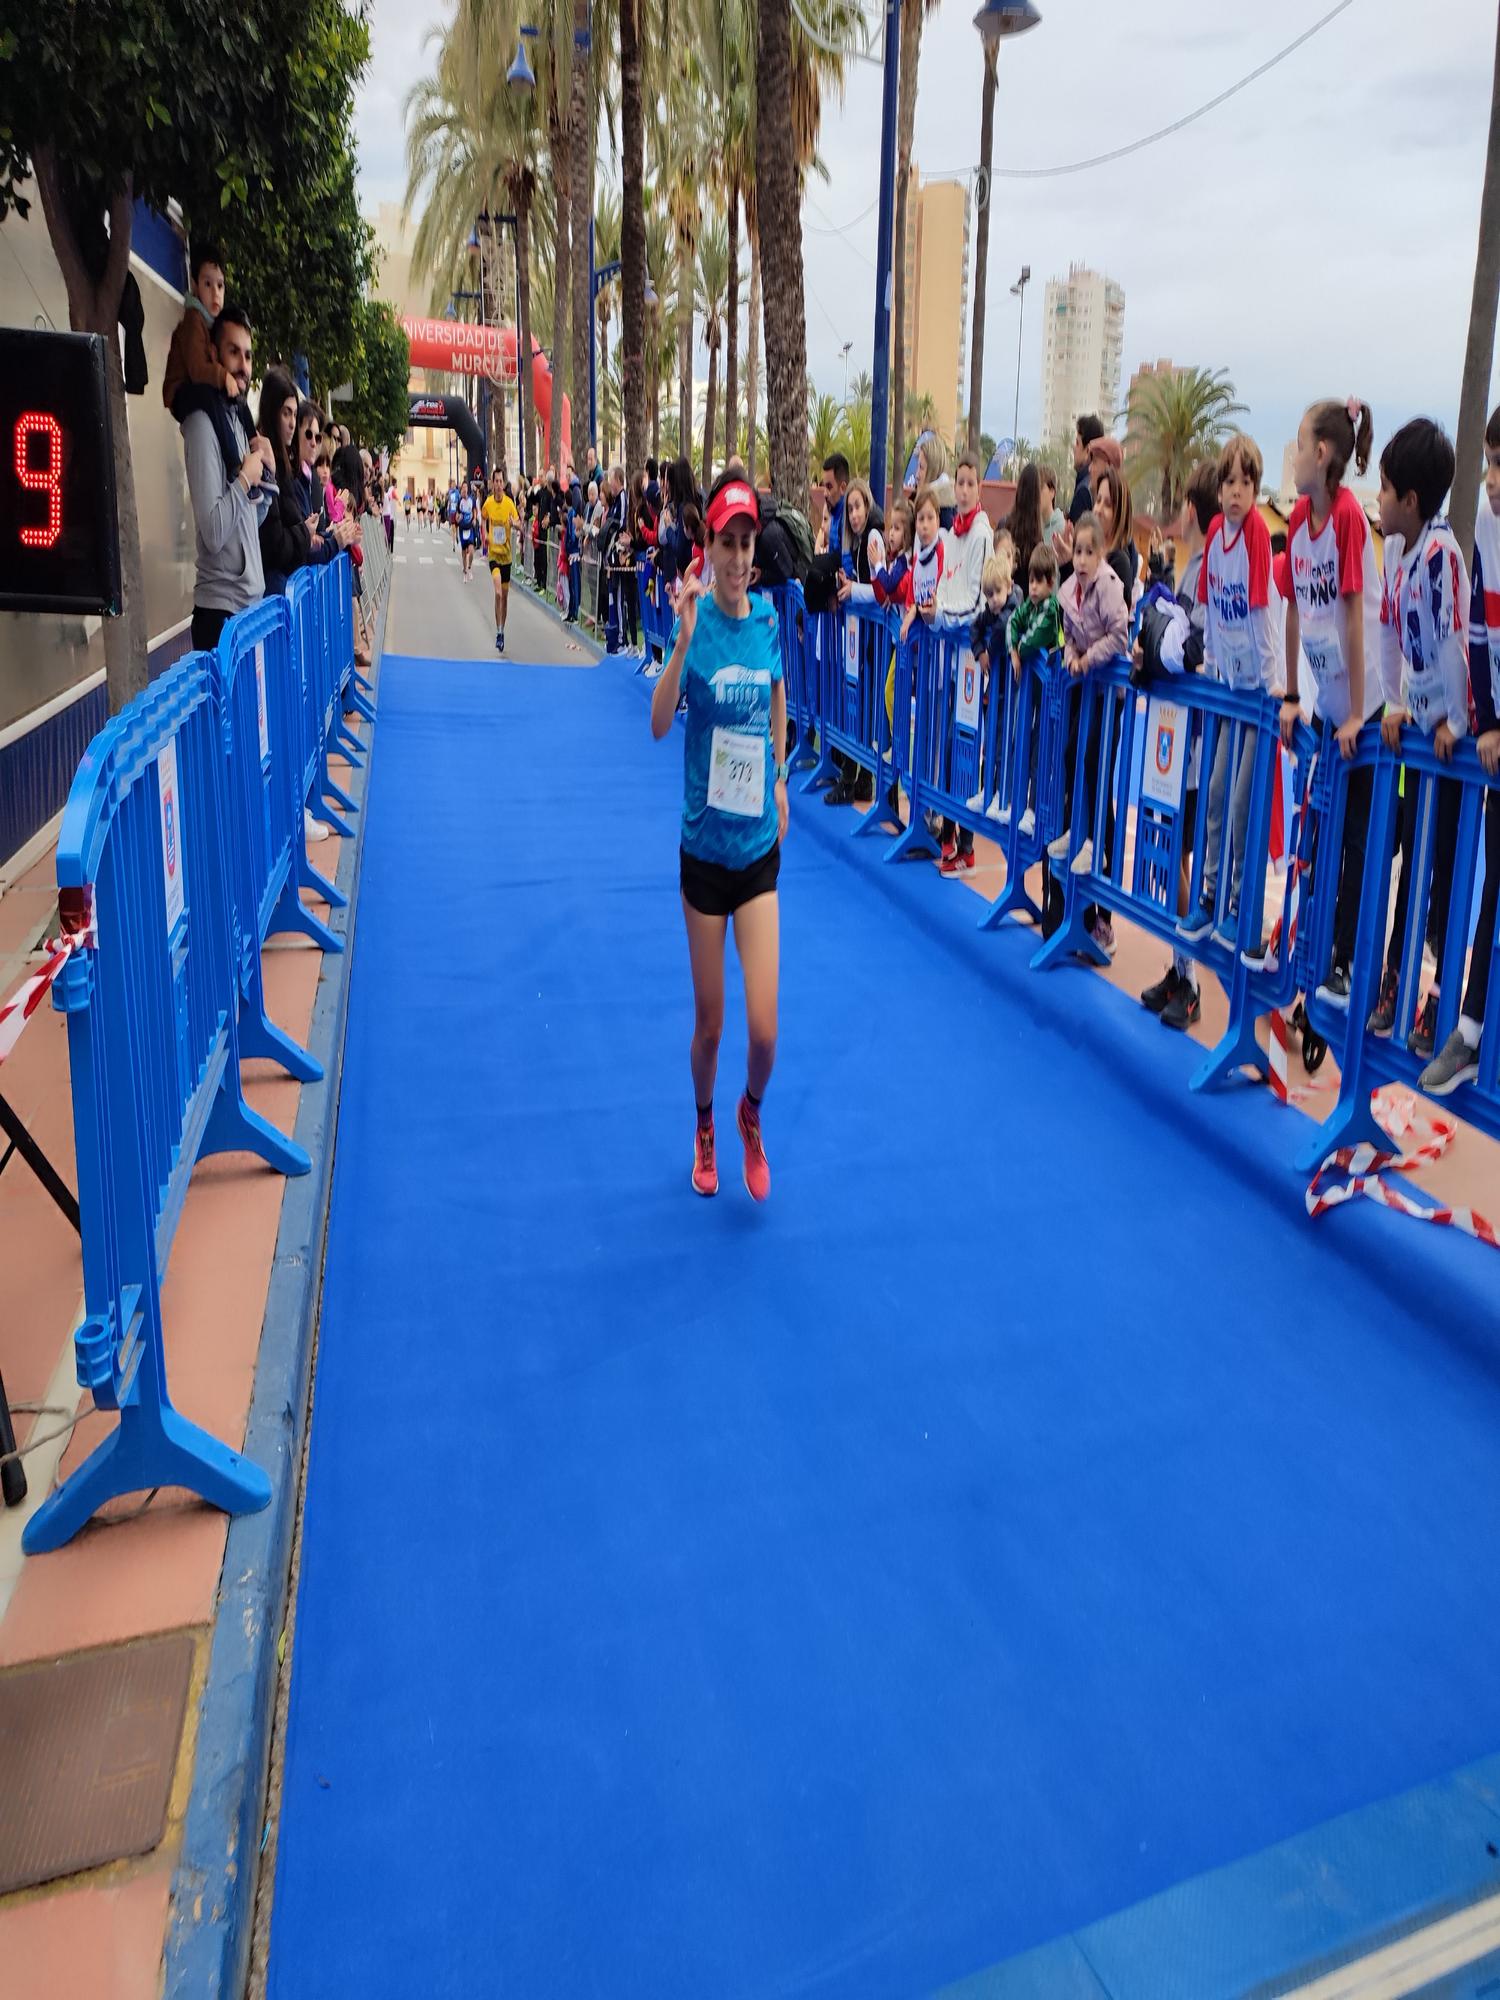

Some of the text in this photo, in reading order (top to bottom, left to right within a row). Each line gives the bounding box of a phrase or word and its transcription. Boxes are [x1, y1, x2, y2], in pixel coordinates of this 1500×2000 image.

[403, 319, 505, 350] NIVERSIDAD DE
[452, 351, 504, 375] MURCIA
[14, 411, 62, 548] 9
